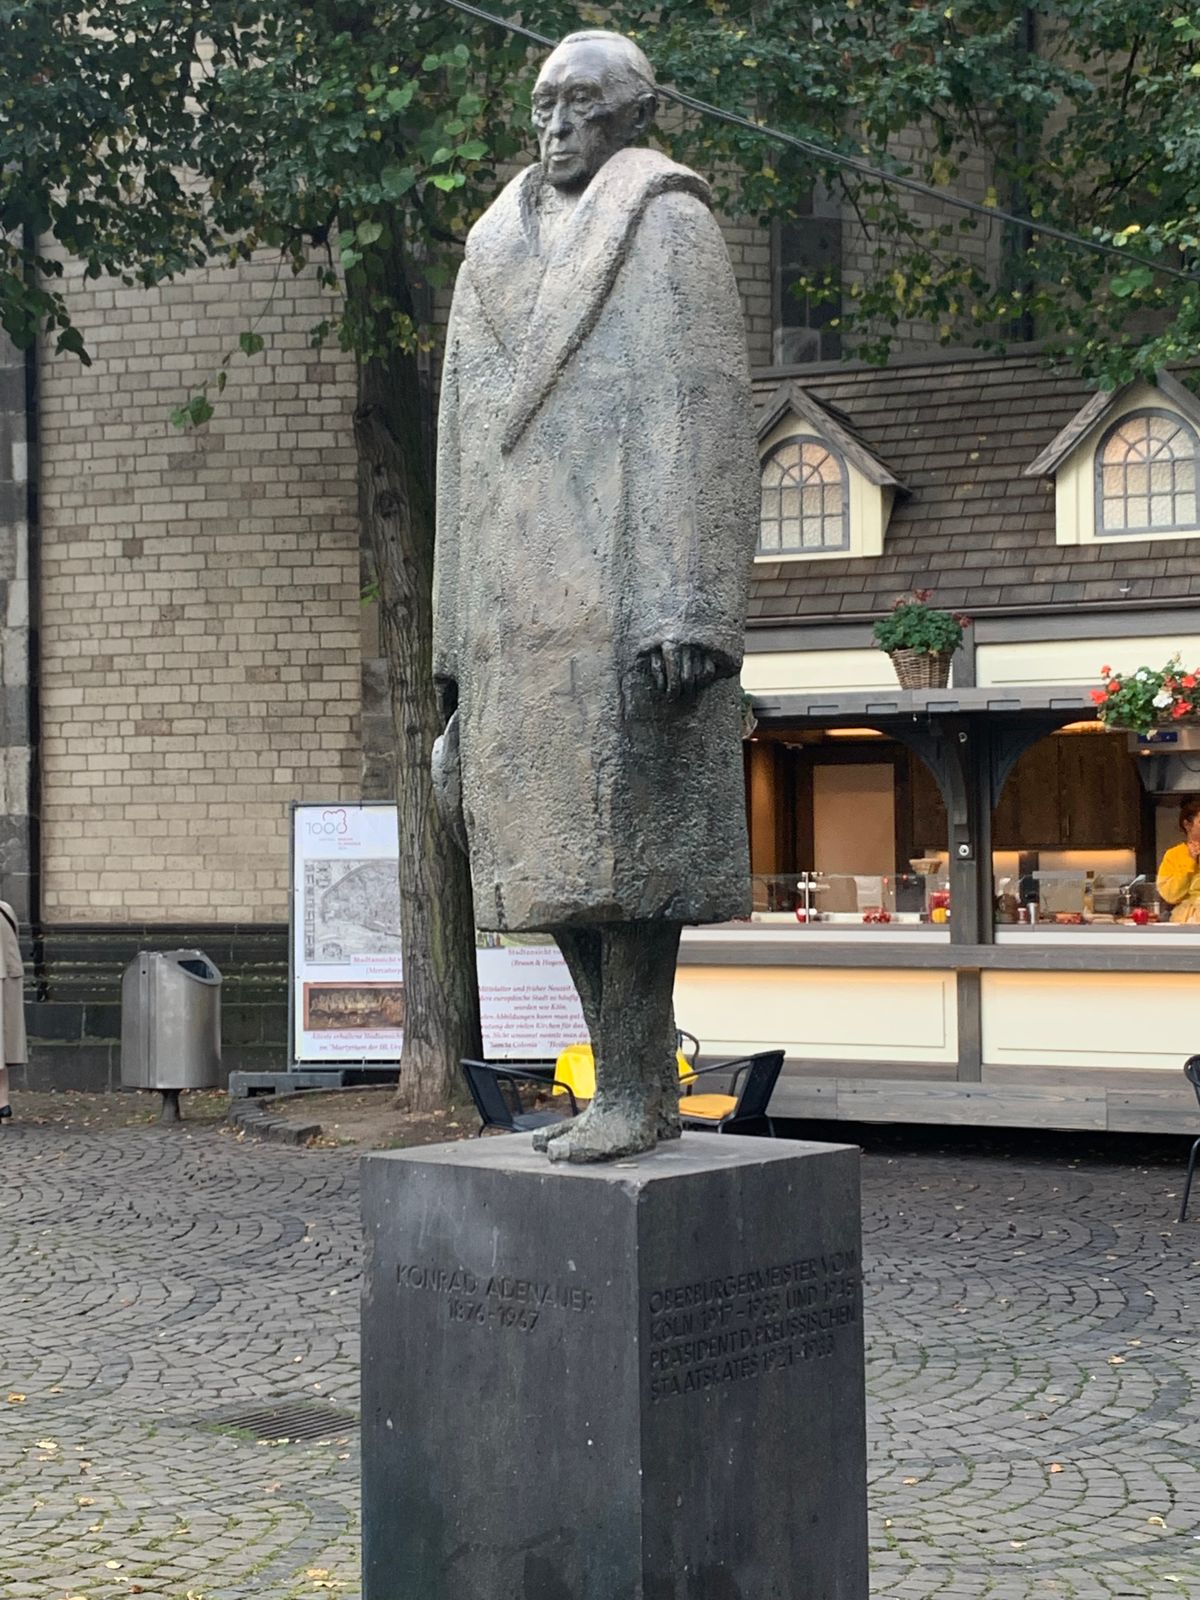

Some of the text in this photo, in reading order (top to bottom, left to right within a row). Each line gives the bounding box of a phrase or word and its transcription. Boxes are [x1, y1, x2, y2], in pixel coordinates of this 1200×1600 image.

[396, 1264, 596, 1315] KONRAD ADENAUER
[786, 1283, 817, 1312] UND
